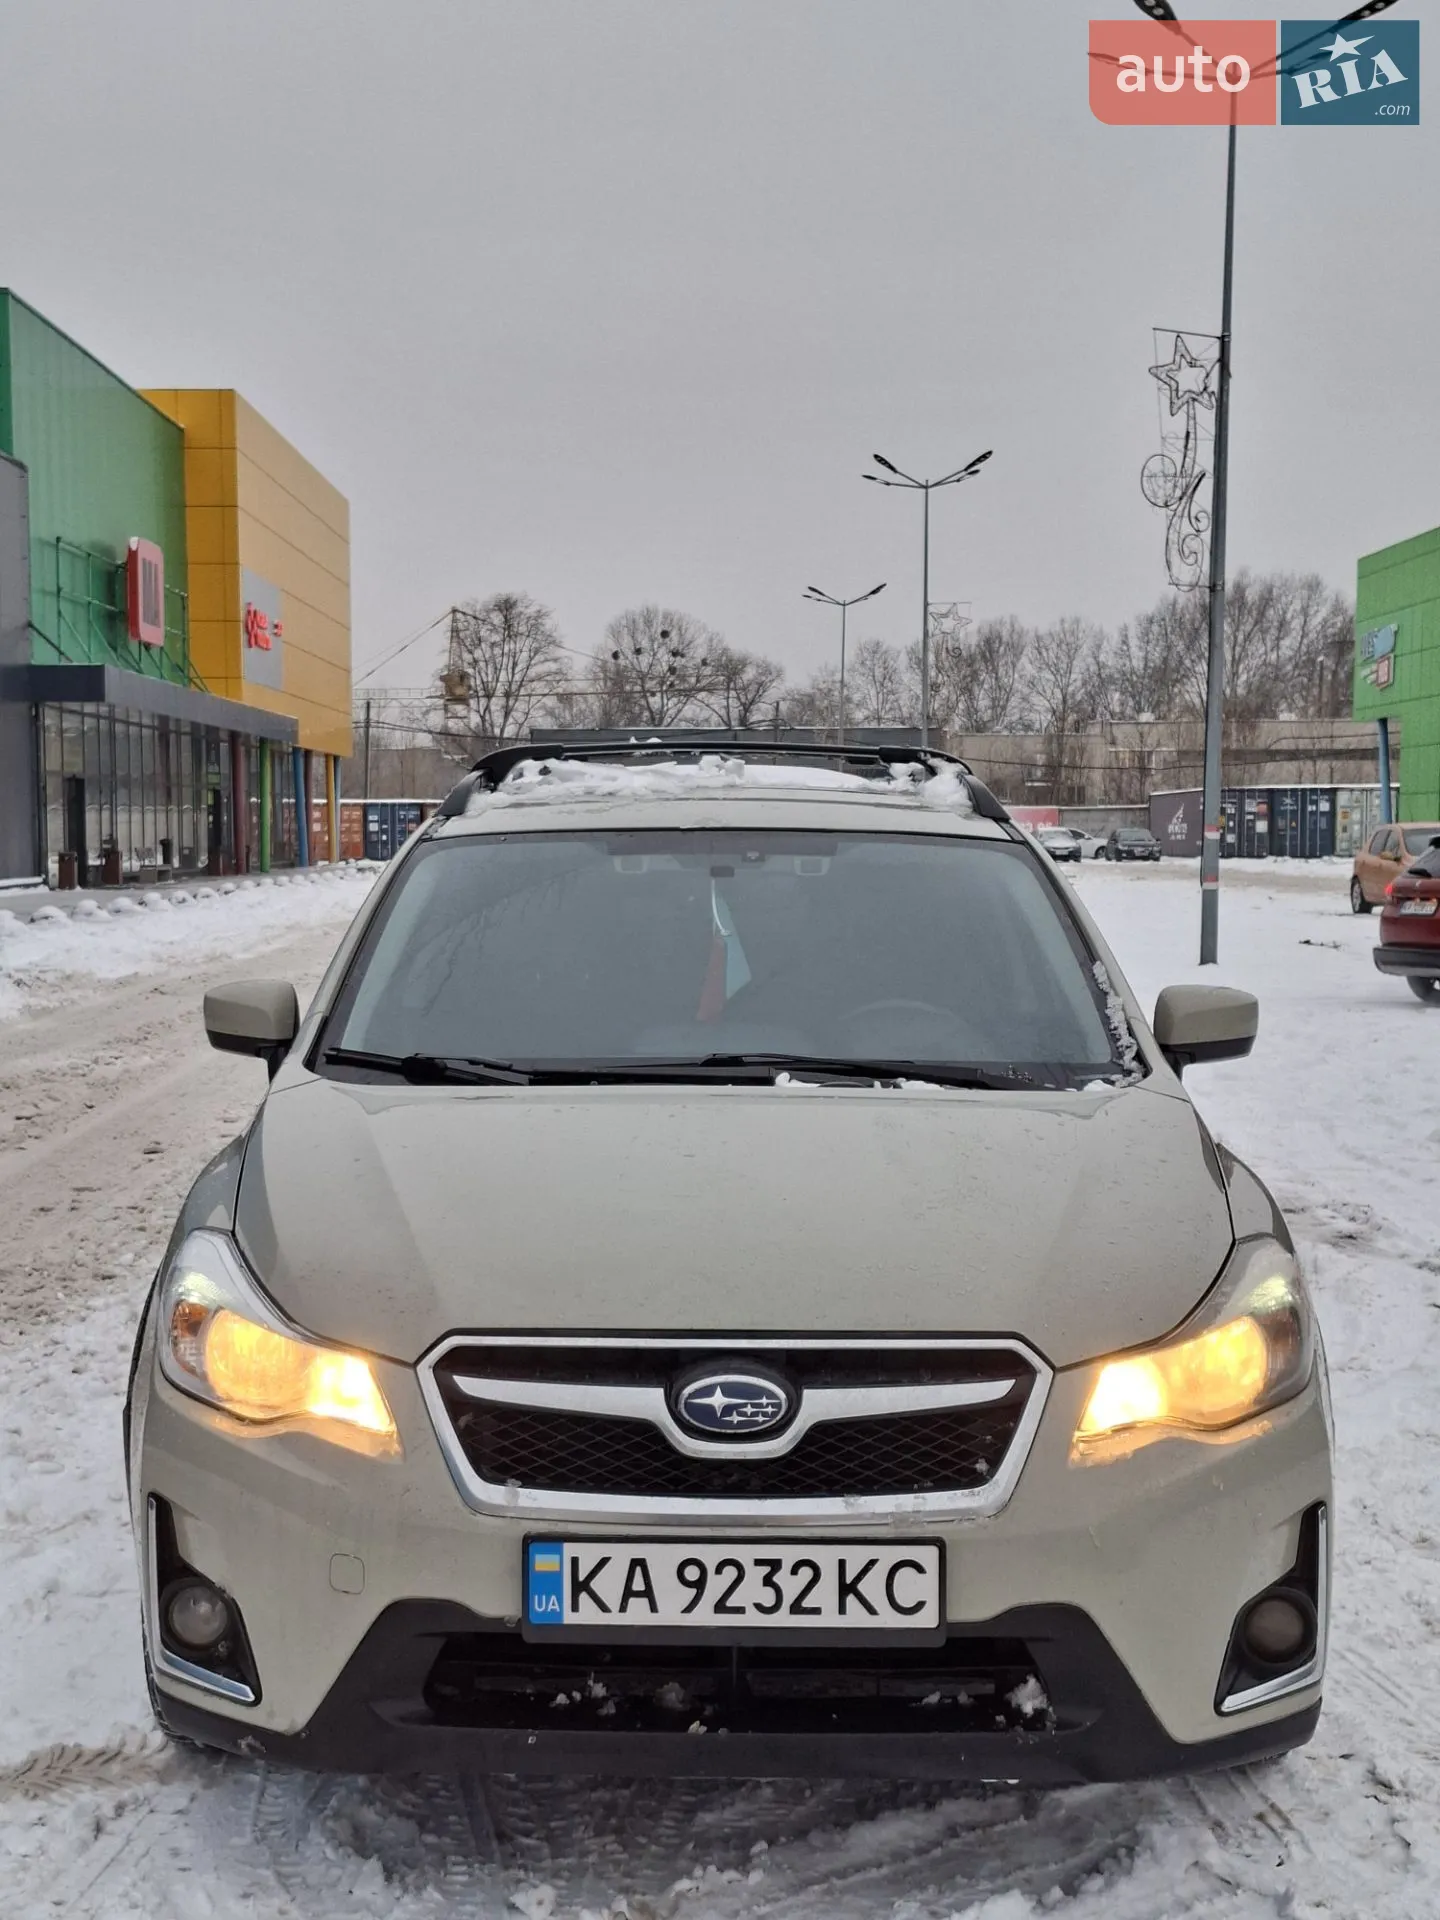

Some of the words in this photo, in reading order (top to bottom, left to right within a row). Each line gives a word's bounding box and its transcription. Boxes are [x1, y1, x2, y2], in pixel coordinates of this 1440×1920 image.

[533, 1593, 561, 1613] UA
[569, 1555, 659, 1614] KA
[676, 1557, 823, 1616] 9232
[837, 1557, 928, 1616] KC
